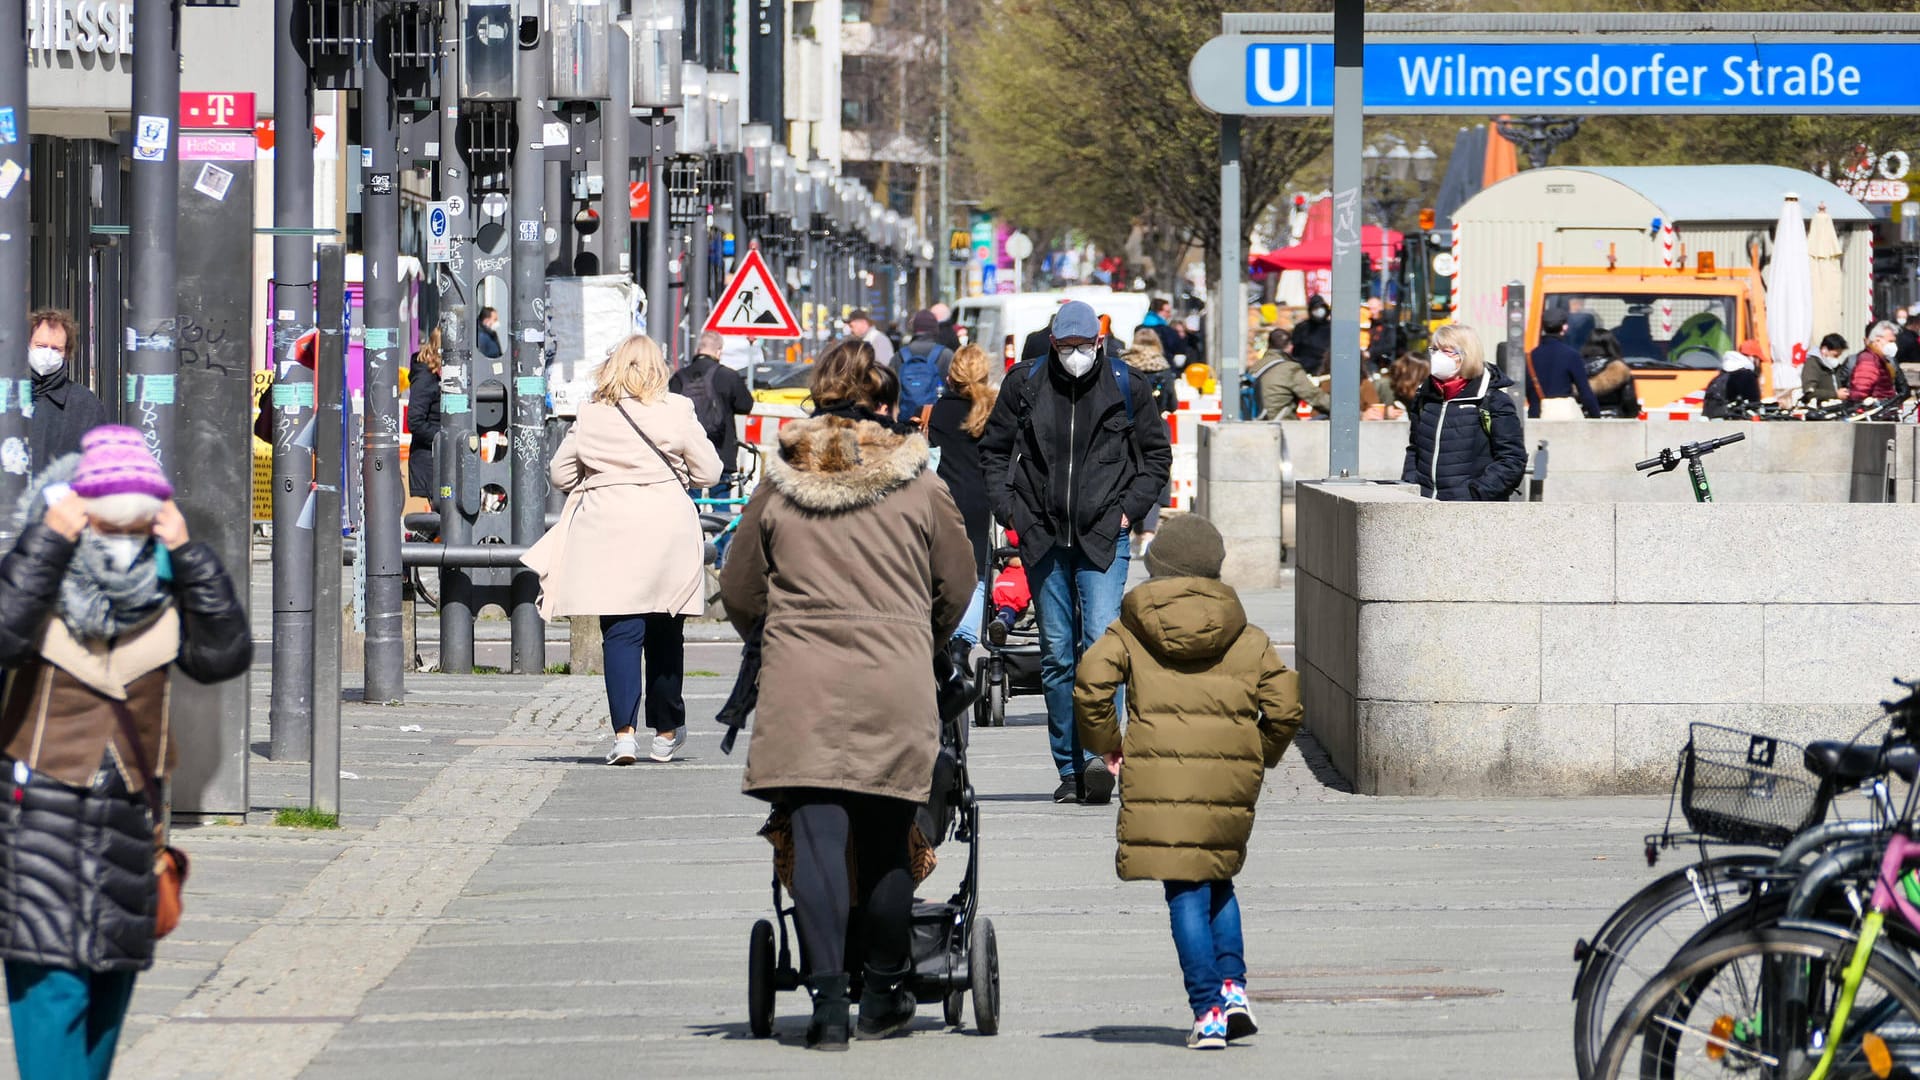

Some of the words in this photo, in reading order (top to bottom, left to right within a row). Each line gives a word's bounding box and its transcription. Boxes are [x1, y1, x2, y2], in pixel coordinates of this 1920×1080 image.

[1256, 49, 1298, 102] U
[1400, 54, 1706, 95] Wilmersdorfer
[1724, 54, 1859, 95] Straße
[207, 94, 234, 126] T
[187, 138, 236, 153] HotSpot
